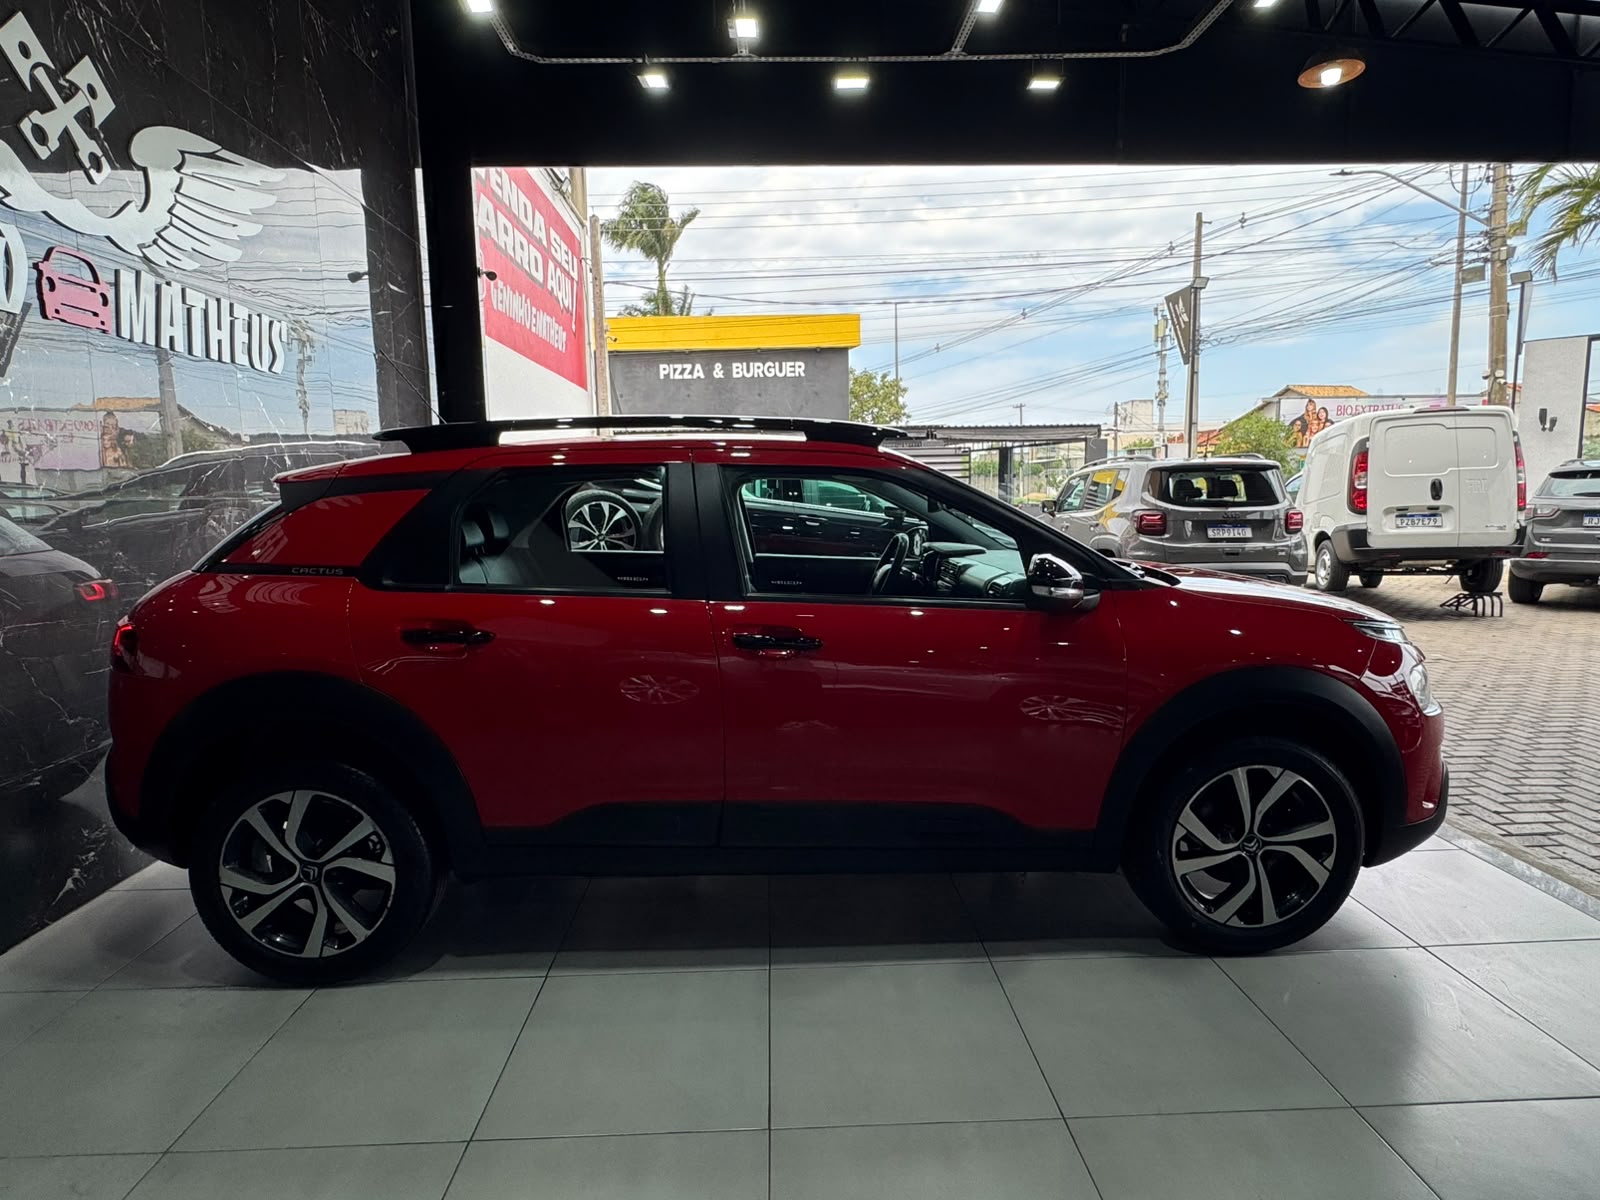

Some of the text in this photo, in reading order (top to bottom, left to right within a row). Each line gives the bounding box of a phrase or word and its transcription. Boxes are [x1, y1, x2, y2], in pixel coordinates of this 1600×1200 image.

[476, 191, 544, 284] ARRO
[549, 226, 579, 281] SEU
[115, 269, 288, 374] MATHEUS
[659, 361, 806, 380] PIZZA & BURGUER
[291, 567, 344, 576] CACTUS
